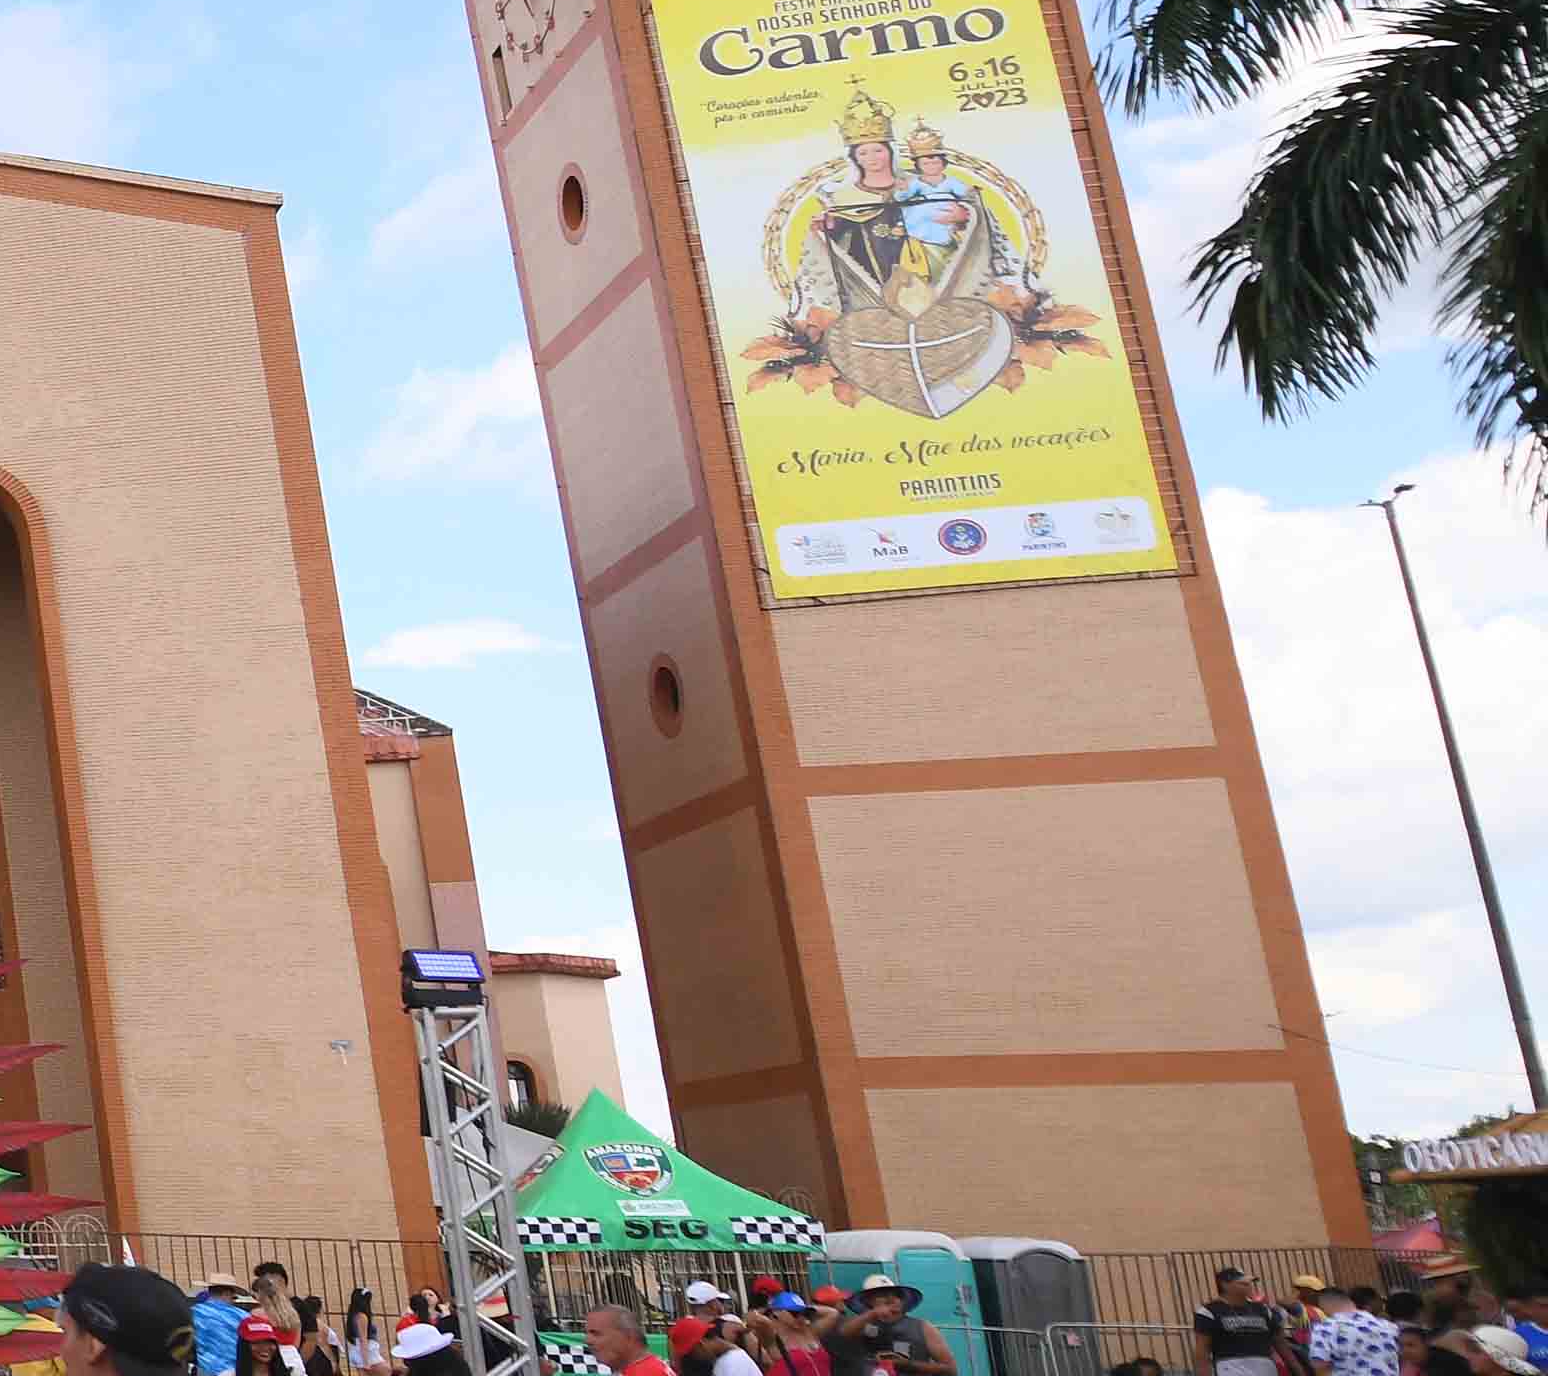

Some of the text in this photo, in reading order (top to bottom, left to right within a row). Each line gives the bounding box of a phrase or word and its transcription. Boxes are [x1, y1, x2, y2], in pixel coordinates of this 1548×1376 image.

[757, 10, 815, 33] NOSSA
[819, 2, 903, 24] SENHORA
[699, 7, 1006, 76] Carmo
[949, 56, 1021, 82] 6 a 16
[953, 77, 1025, 92] JULHO
[960, 432, 1004, 455] das
[1011, 424, 1113, 453] vocações
[899, 473, 1002, 497] PARINTINS
[625, 1218, 709, 1241] SEG
